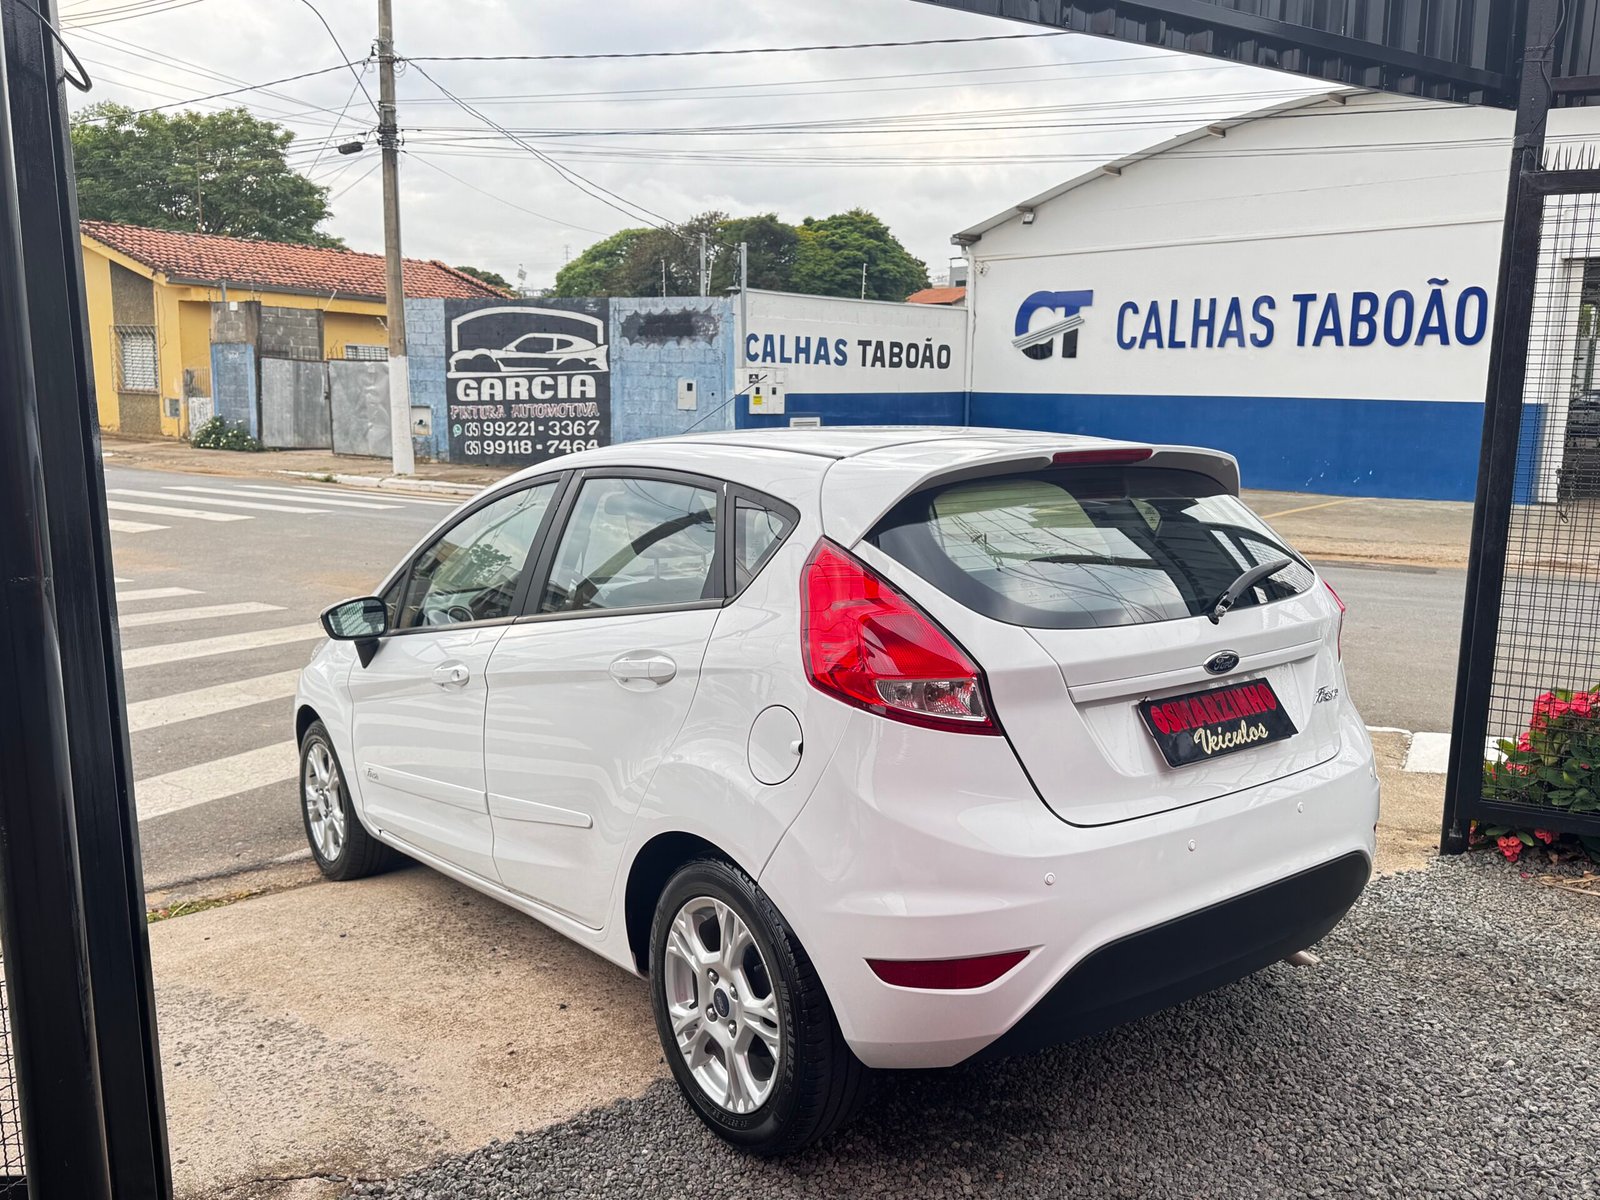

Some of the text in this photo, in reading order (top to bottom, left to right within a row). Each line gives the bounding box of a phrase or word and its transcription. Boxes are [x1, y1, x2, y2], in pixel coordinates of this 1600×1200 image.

[1116, 277, 1489, 351] CALHAS TABOÃO
[746, 333, 951, 370] CALHAS TABOÃO
[456, 374, 597, 402] GARCIA
[450, 401, 600, 421] PINTURA AUTOMOTIVA
[464, 422, 482, 437] (35)
[464, 440, 482, 455] (35)
[1152, 684, 1277, 735] OSMARZINHO
